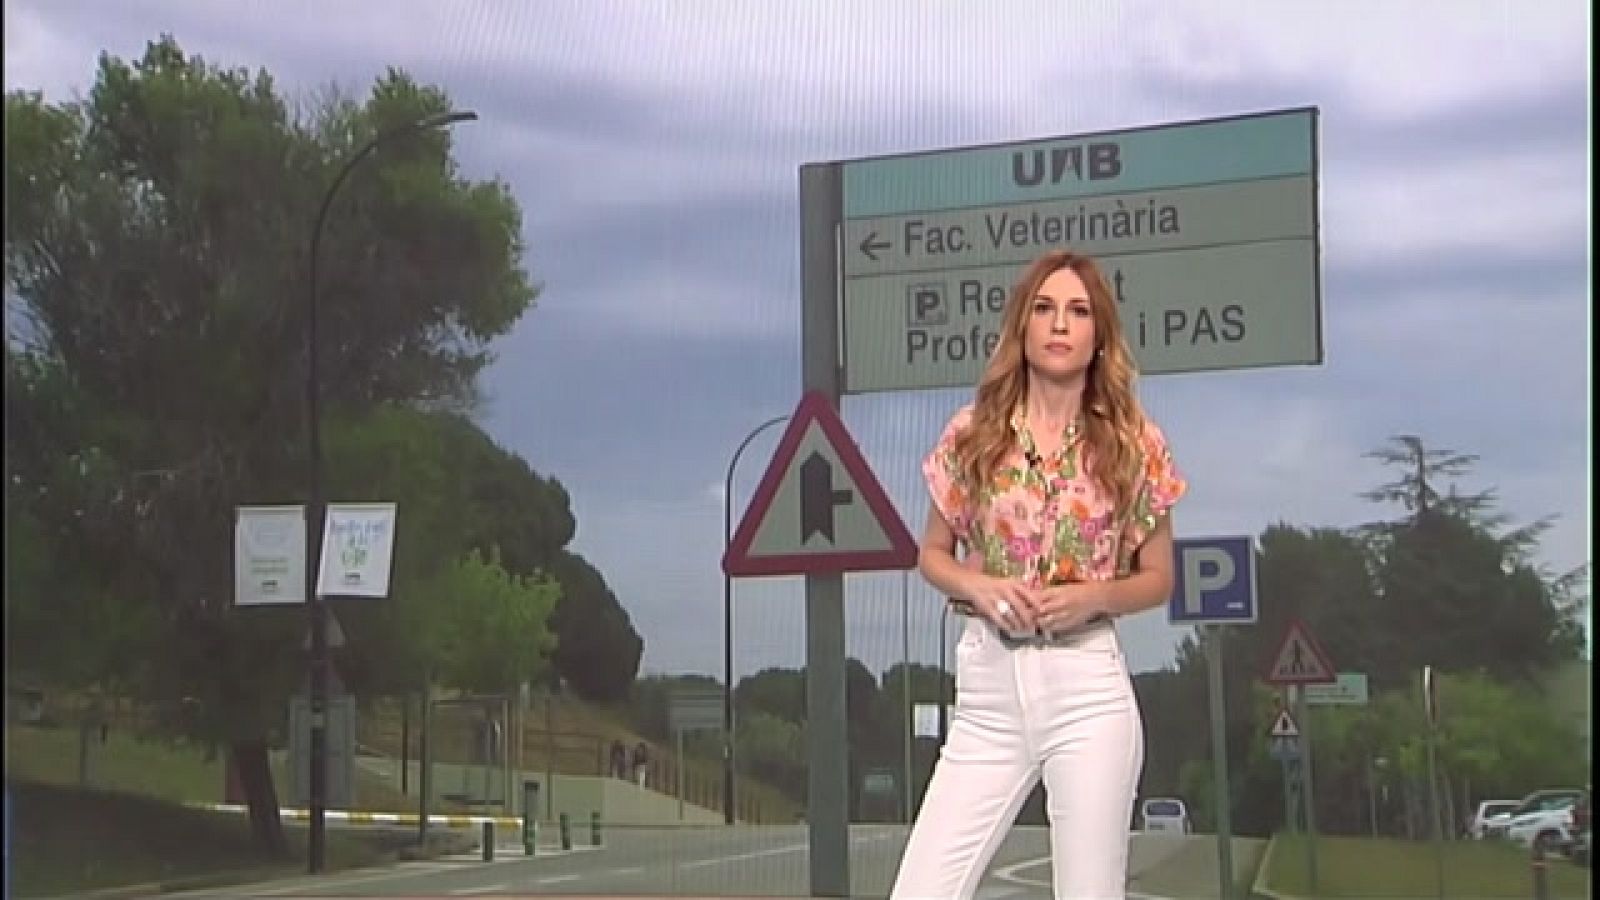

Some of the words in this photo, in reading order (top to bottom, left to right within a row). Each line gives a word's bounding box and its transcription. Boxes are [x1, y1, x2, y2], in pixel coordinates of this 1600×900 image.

[1012, 143, 1122, 187] UAB
[904, 219, 972, 257] Fac.
[985, 199, 1181, 248] Veterinària
[915, 290, 940, 320] P
[1139, 311, 1147, 348] i
[1164, 304, 1246, 346] PAS
[1183, 546, 1236, 614] P
